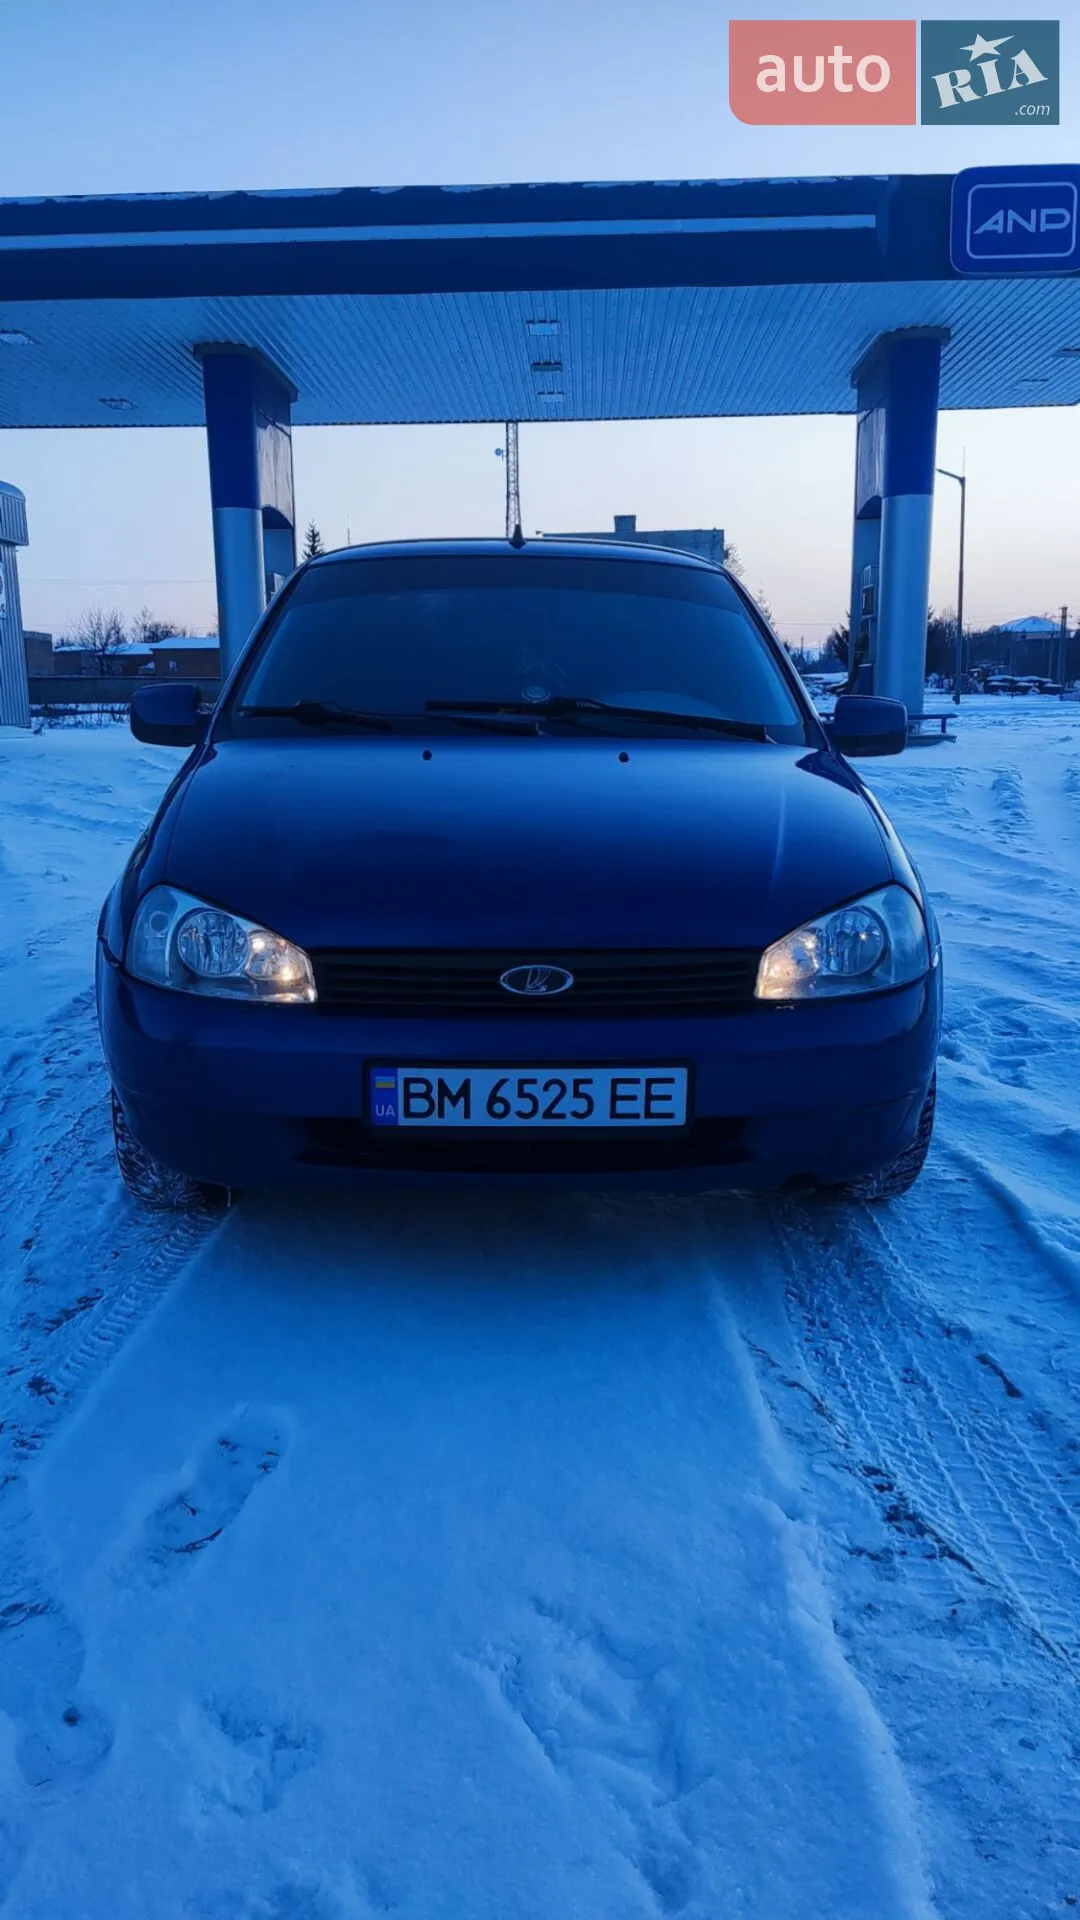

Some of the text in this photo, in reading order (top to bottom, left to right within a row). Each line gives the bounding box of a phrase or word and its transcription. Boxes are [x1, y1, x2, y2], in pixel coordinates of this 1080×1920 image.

[973, 208, 1071, 235] ANP
[375, 1104, 396, 1117] UA
[402, 1077, 676, 1120] BM 6525 EE
